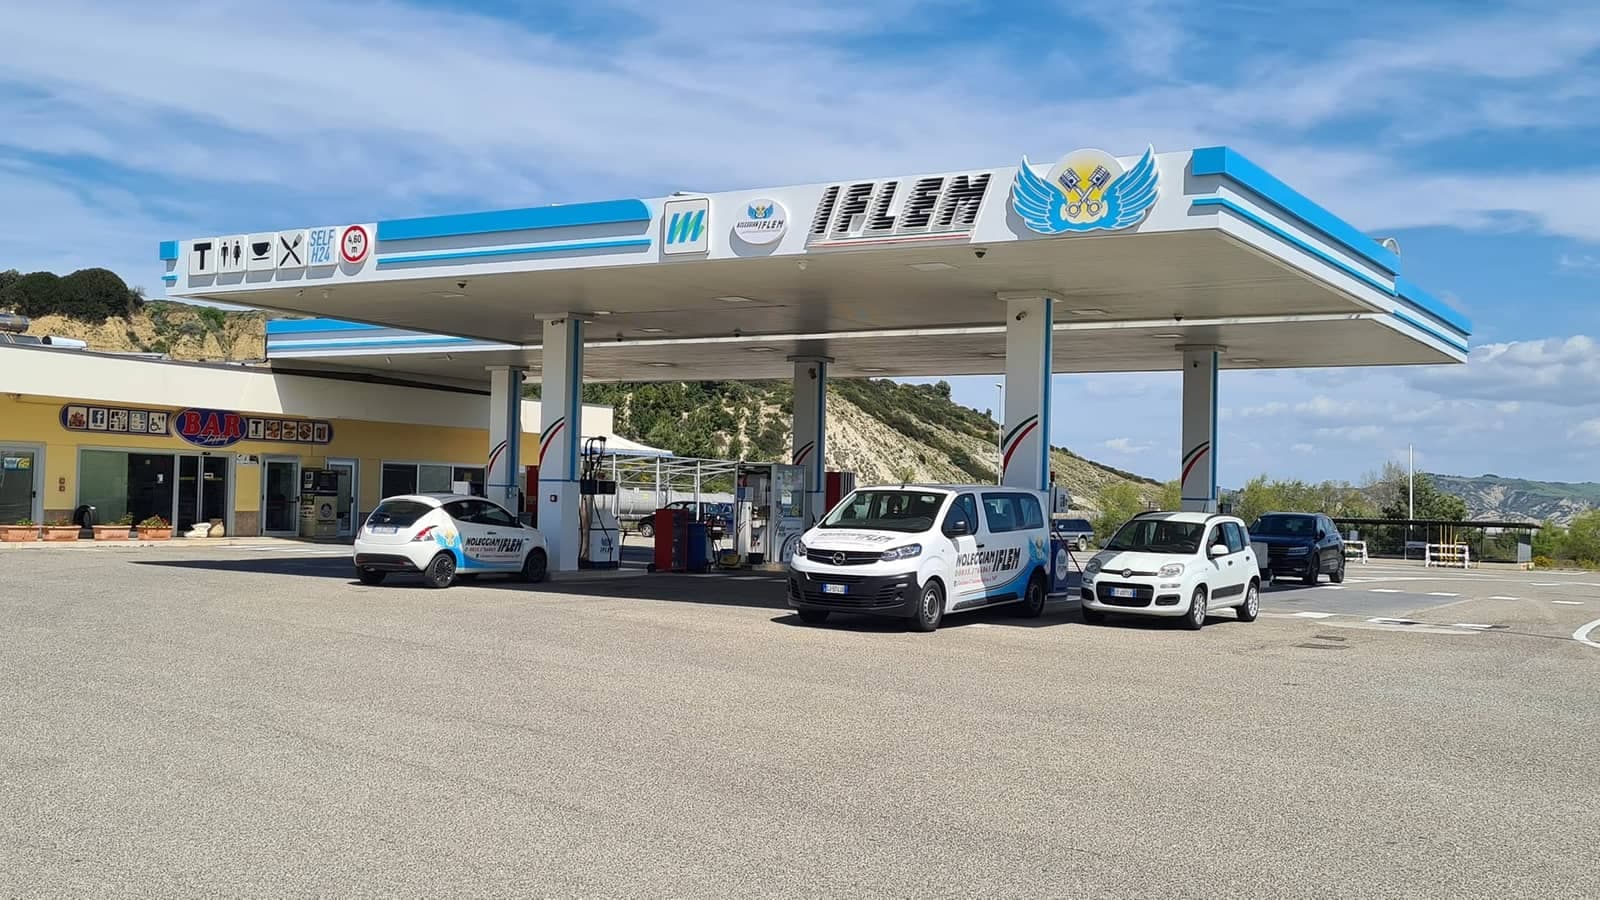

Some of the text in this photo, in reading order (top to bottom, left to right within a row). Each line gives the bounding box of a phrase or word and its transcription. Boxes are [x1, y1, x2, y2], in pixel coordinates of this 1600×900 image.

[809, 172, 991, 236] IFLEM
[757, 220, 784, 230] IFLEM
[311, 229, 335, 246] SELF
[194, 242, 212, 270] T
[311, 246, 330, 262] H24
[182, 411, 241, 438] BAR
